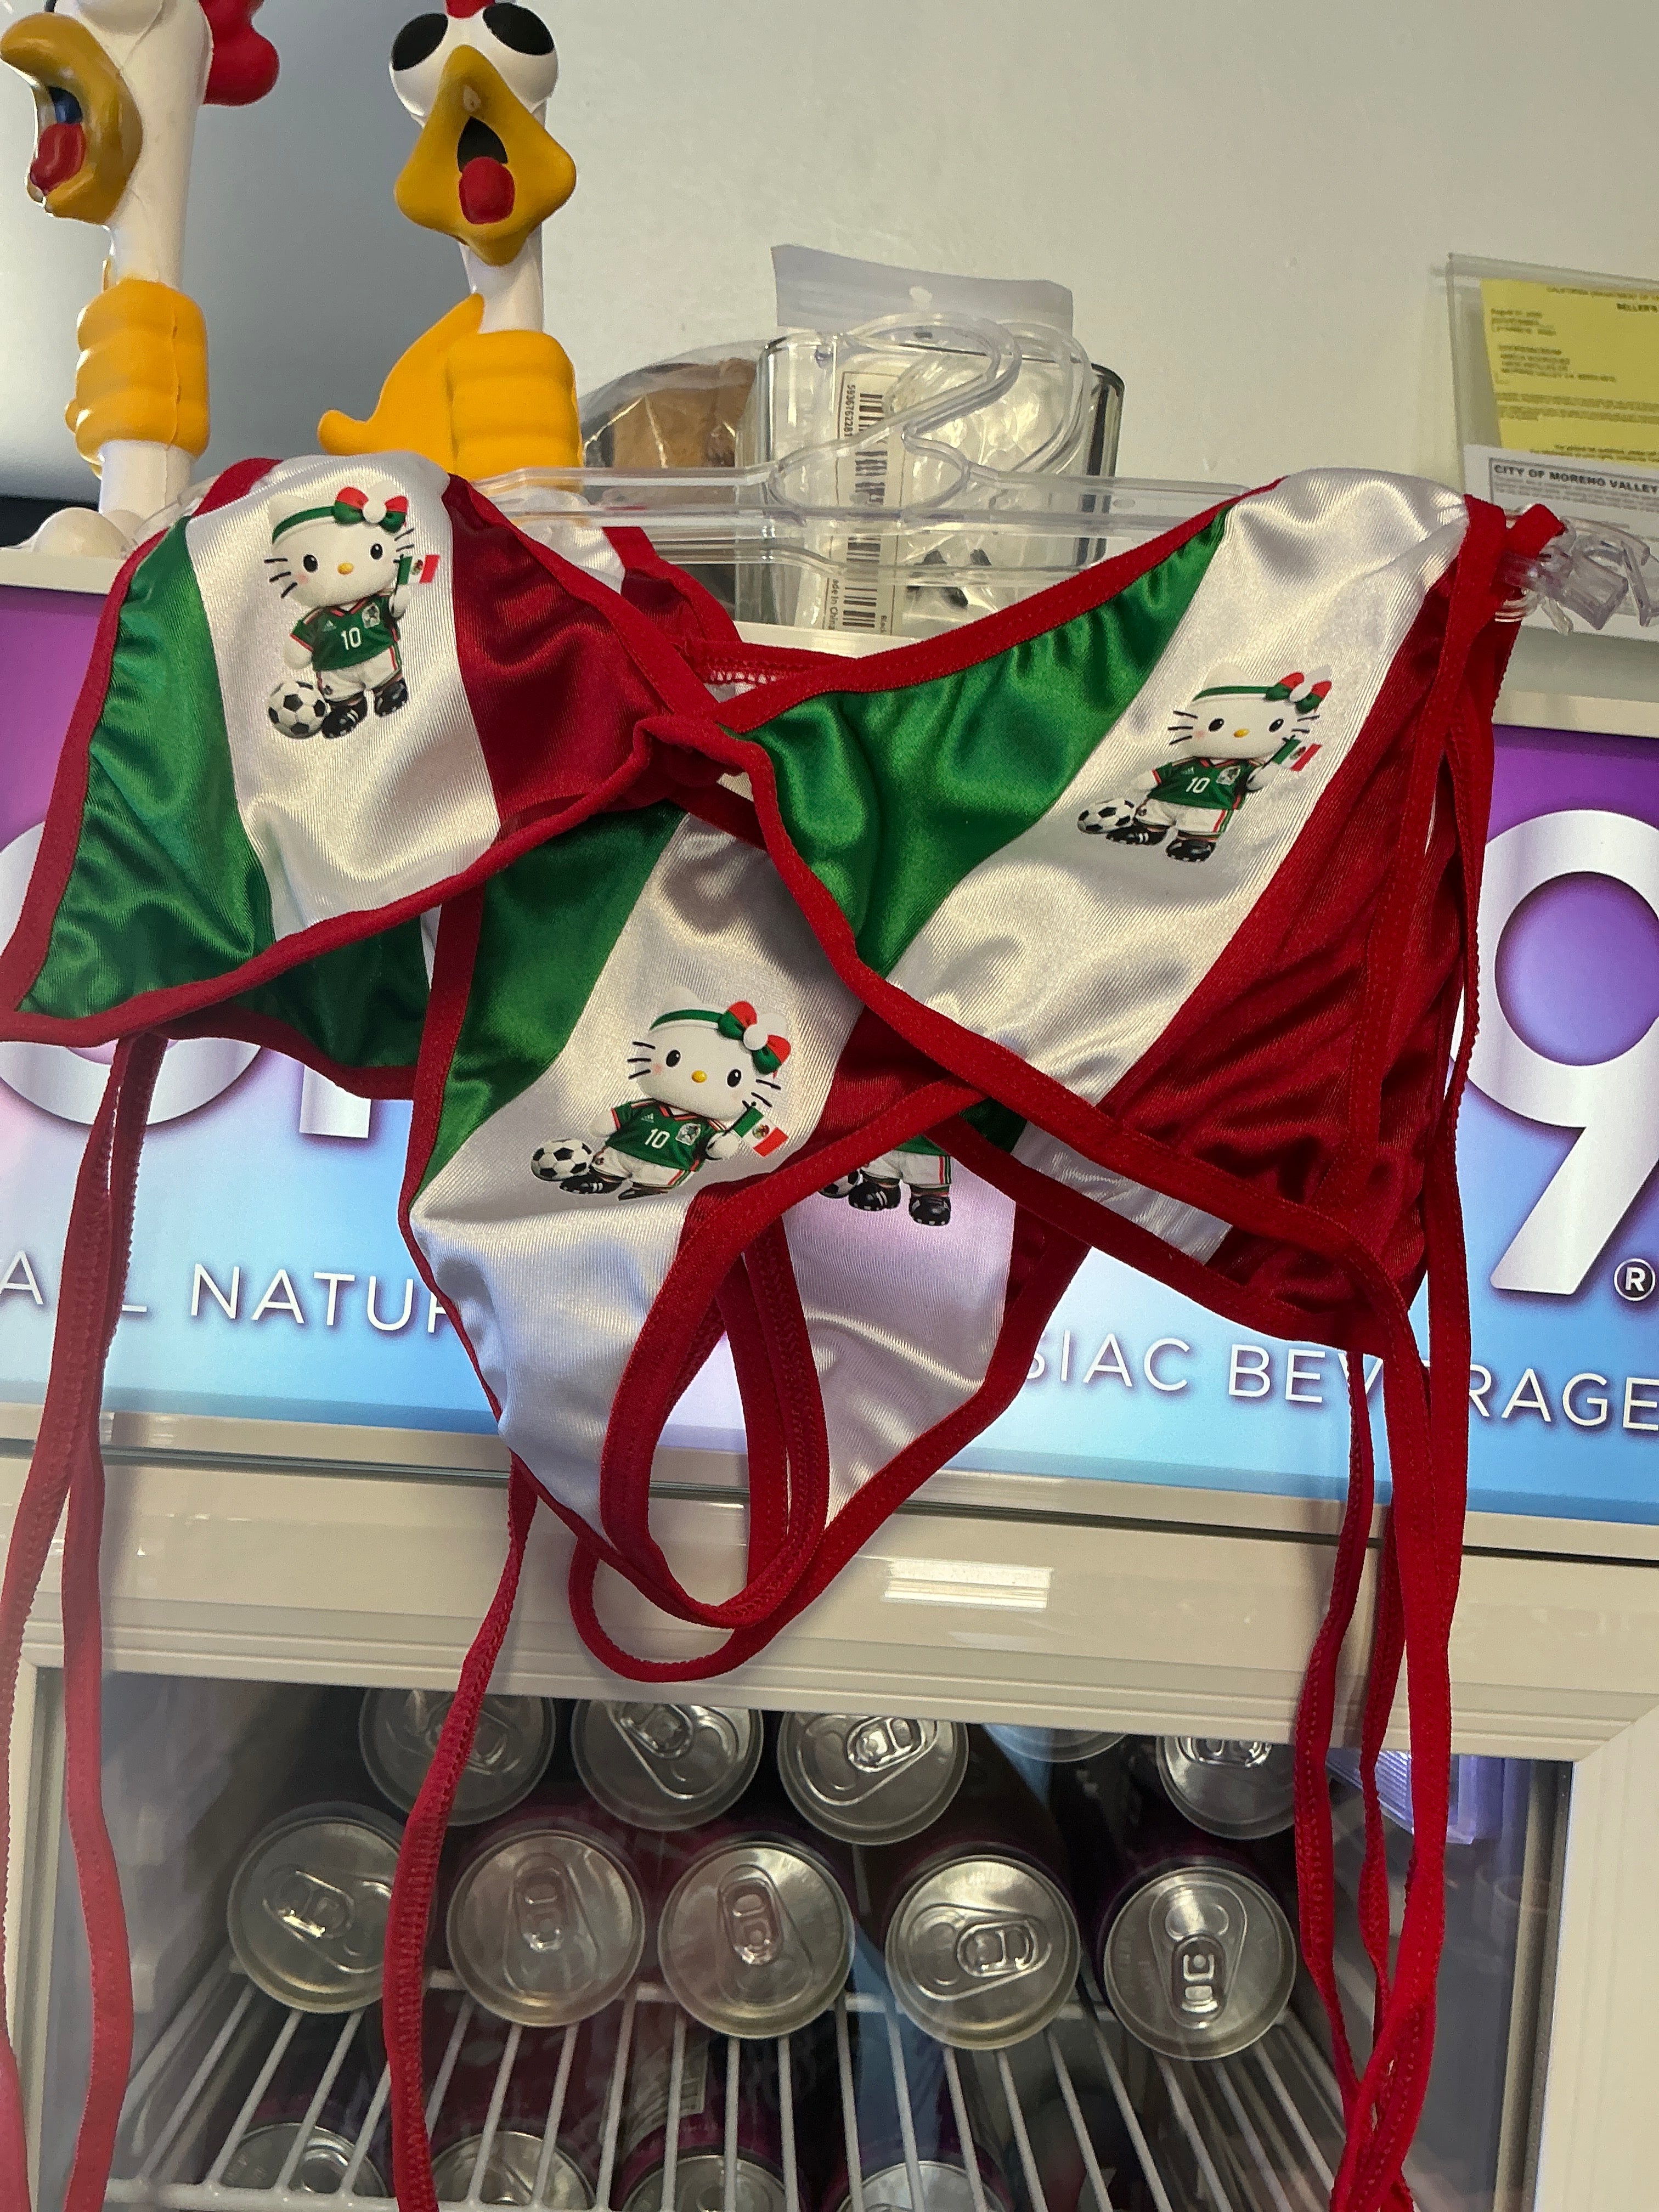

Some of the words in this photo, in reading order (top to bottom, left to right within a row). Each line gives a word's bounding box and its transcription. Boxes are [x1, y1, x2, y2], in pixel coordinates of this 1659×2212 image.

[1494, 465, 1524, 476] CITY
[1528, 469, 1545, 478] OF
[1549, 471, 1606, 487] MORENO
[1610, 479, 1658, 494] VALLEY
[341, 627, 362, 650] 10
[1186, 776, 1210, 794] 10
[644, 1128, 670, 1149] 10
